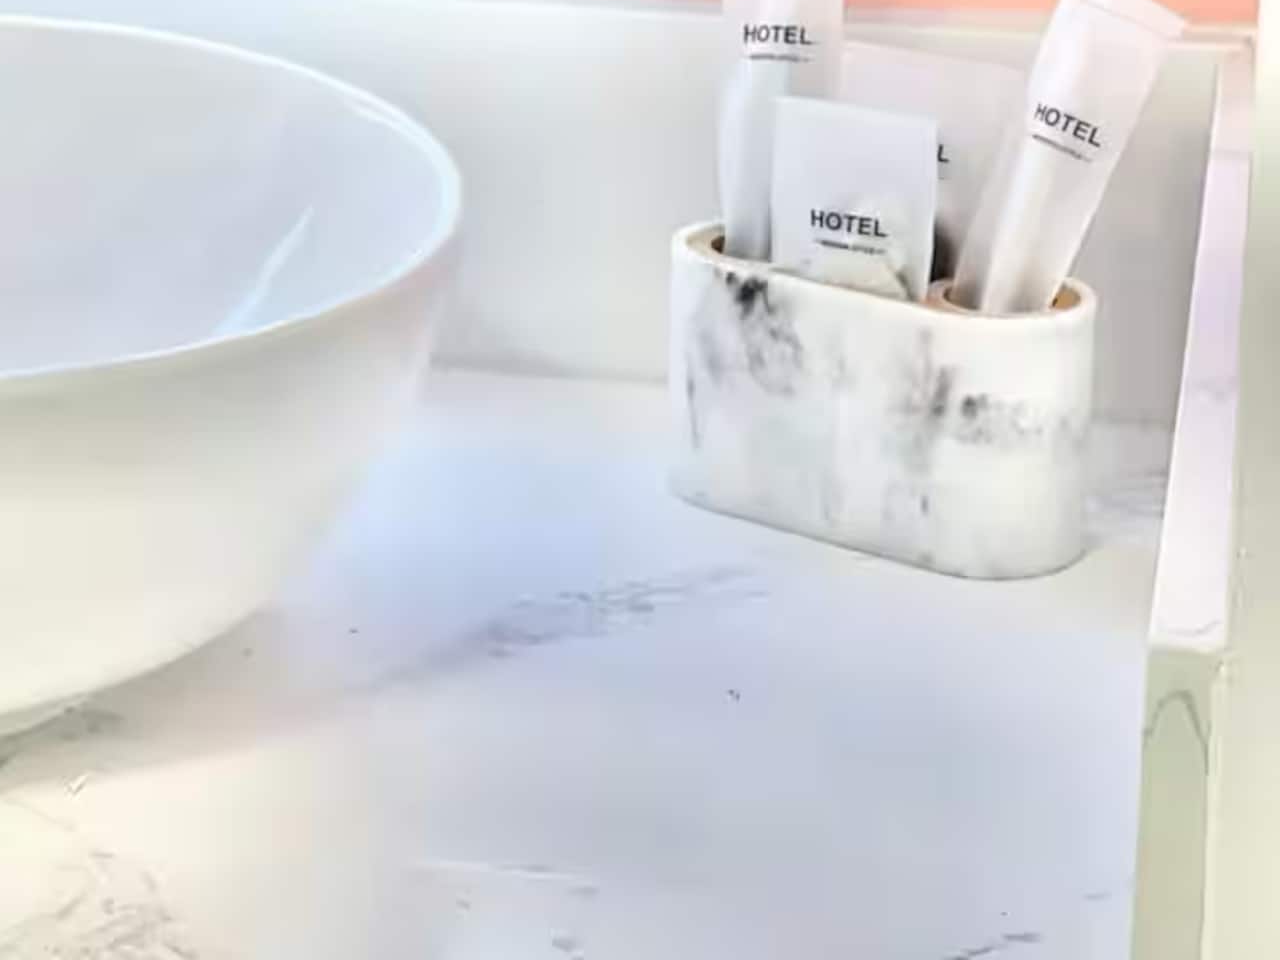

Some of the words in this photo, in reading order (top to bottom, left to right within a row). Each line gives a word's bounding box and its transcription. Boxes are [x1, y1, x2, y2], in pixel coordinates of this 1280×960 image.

[743, 24, 813, 45] HOTEL
[1034, 102, 1101, 148] HOTEL
[810, 208, 888, 238] HOTEL
